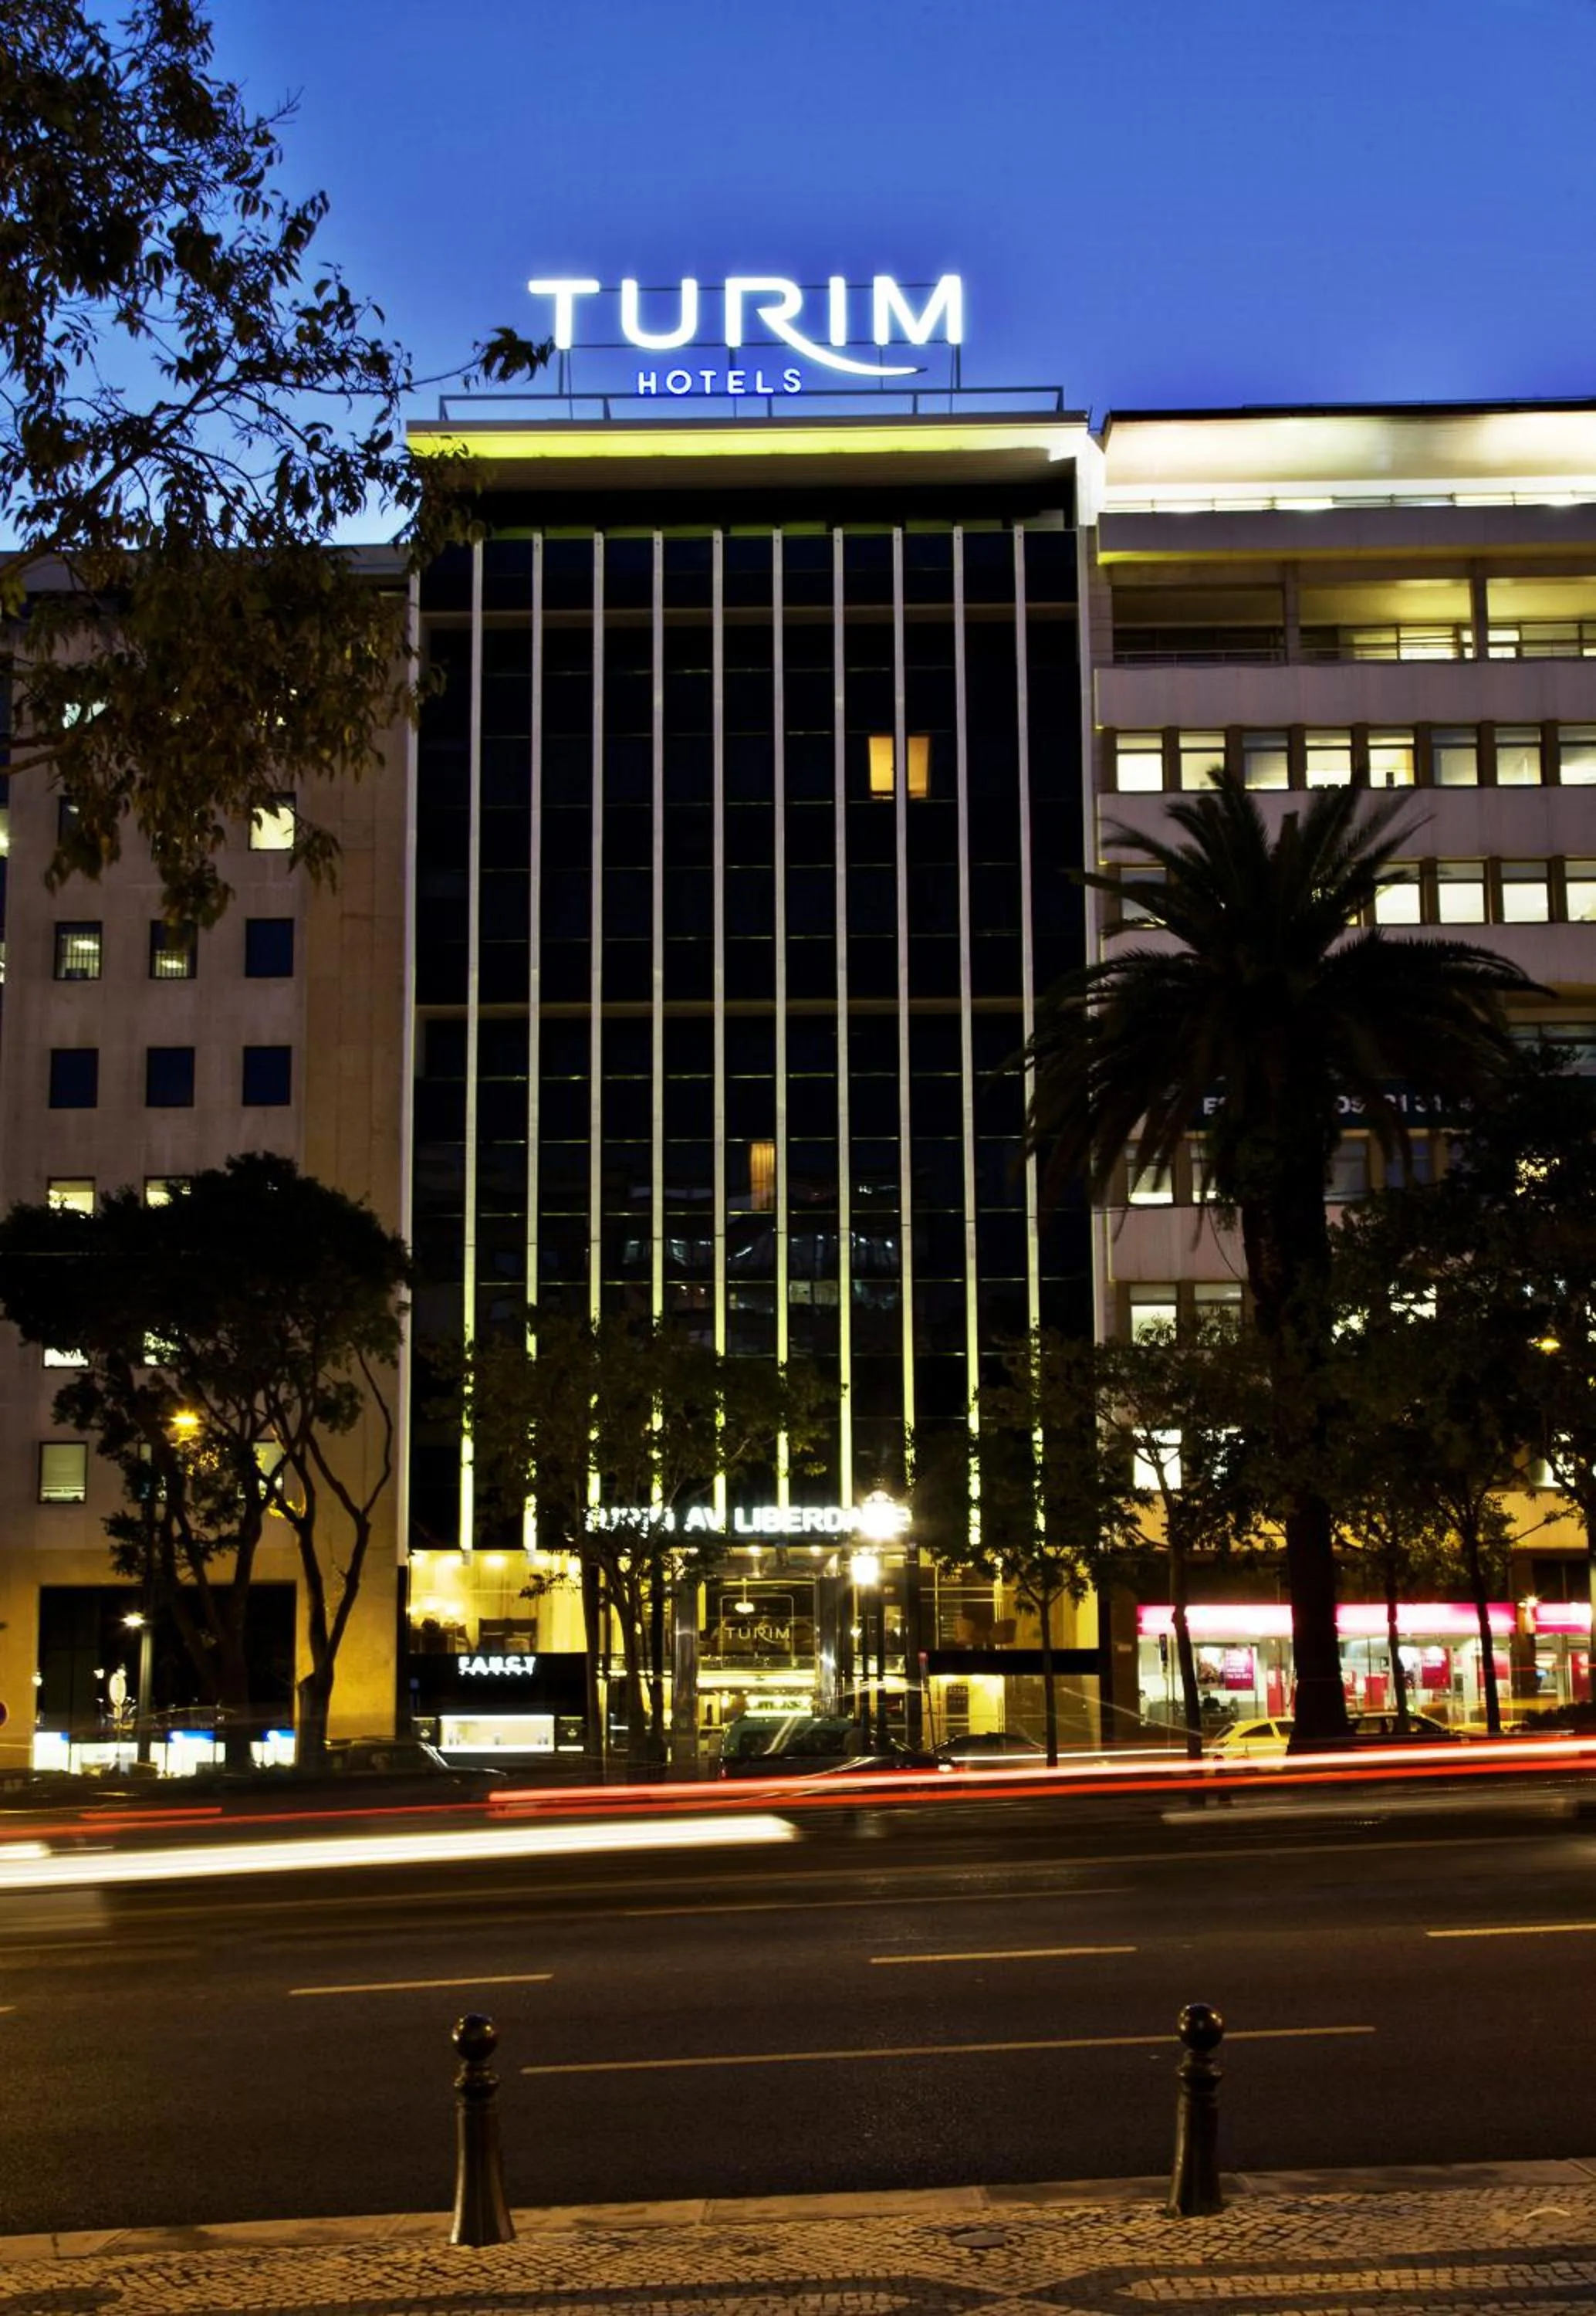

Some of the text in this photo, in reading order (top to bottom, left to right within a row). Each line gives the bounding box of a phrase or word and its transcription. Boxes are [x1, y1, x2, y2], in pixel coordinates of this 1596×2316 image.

[529, 275, 962, 376] TURIM
[638, 369, 801, 394] HOTELS
[684, 1507, 725, 1532] AV
[735, 1507, 912, 1532] LIBERDAE
[725, 1627, 790, 1643] TURIM
